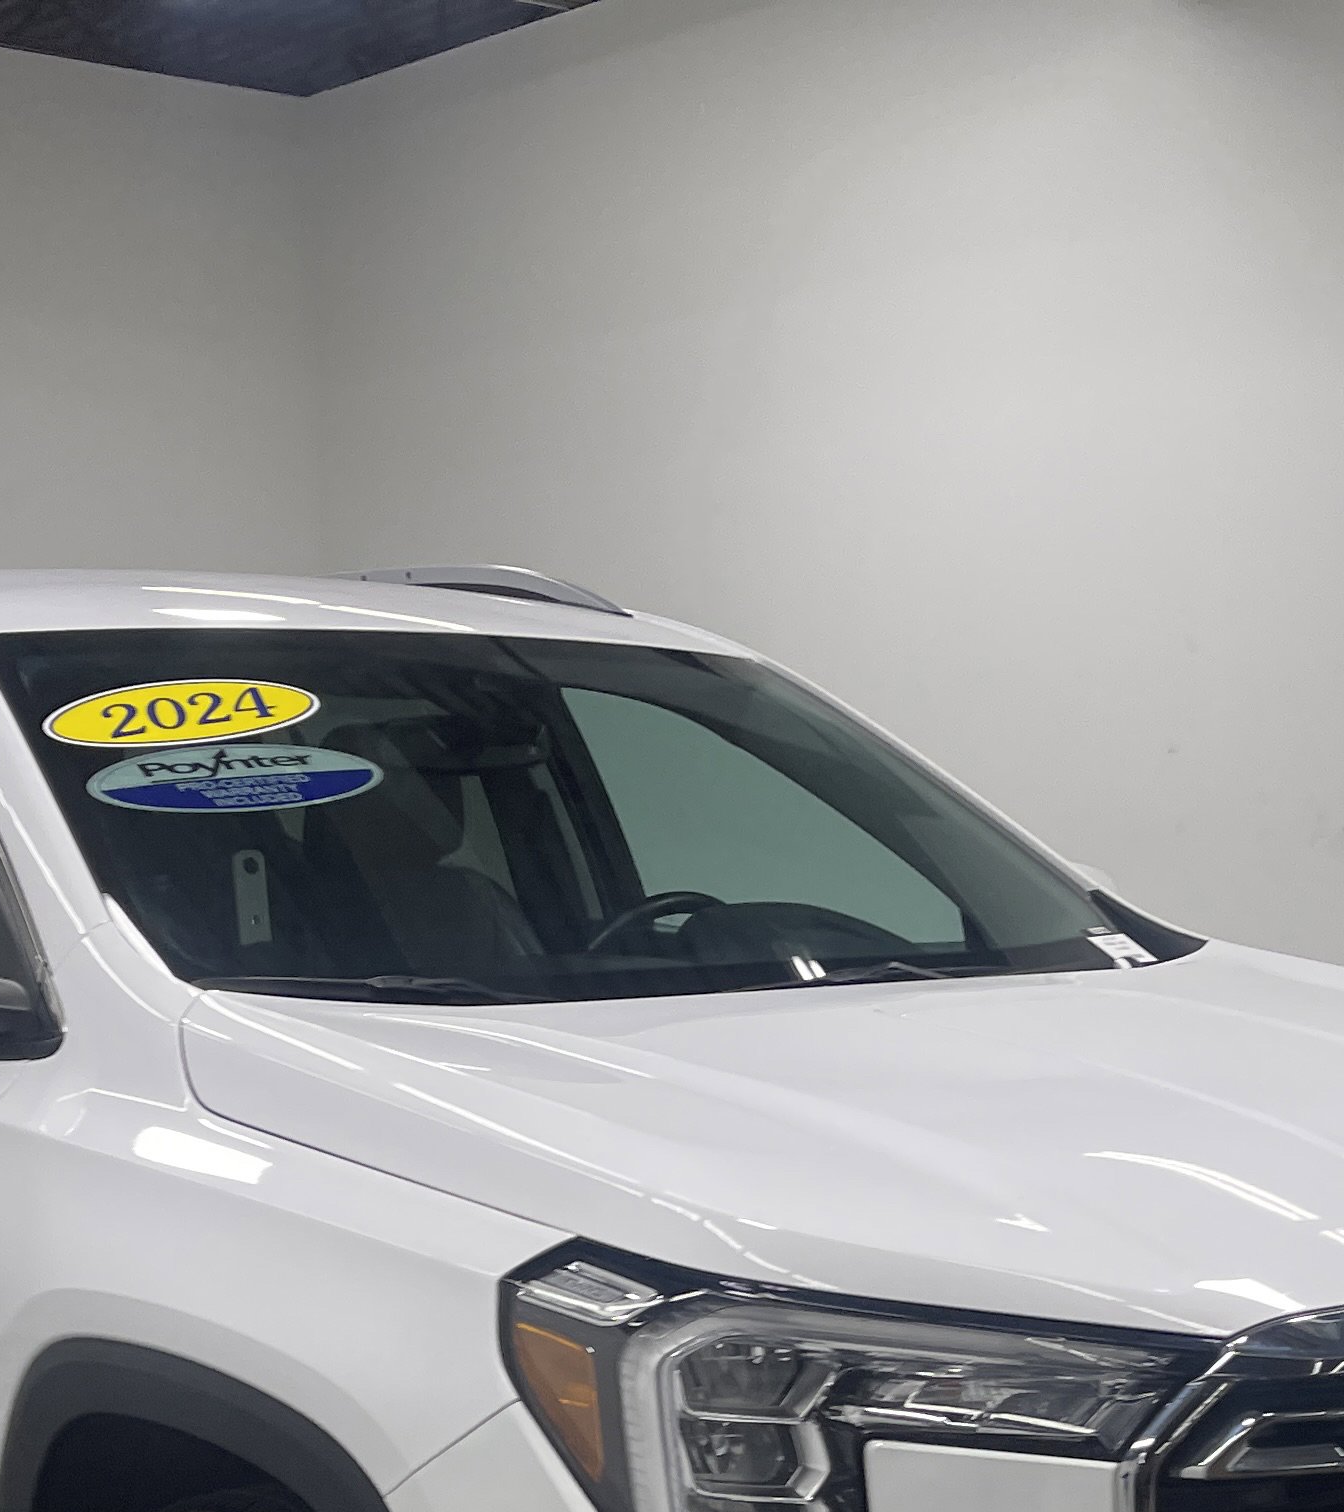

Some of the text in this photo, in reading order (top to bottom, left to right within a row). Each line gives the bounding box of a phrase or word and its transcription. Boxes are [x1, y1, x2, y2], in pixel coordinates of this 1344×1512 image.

[102, 687, 278, 738] 2024
[136, 750, 312, 780] Poynter
[212, 792, 304, 806] INCLUDED
